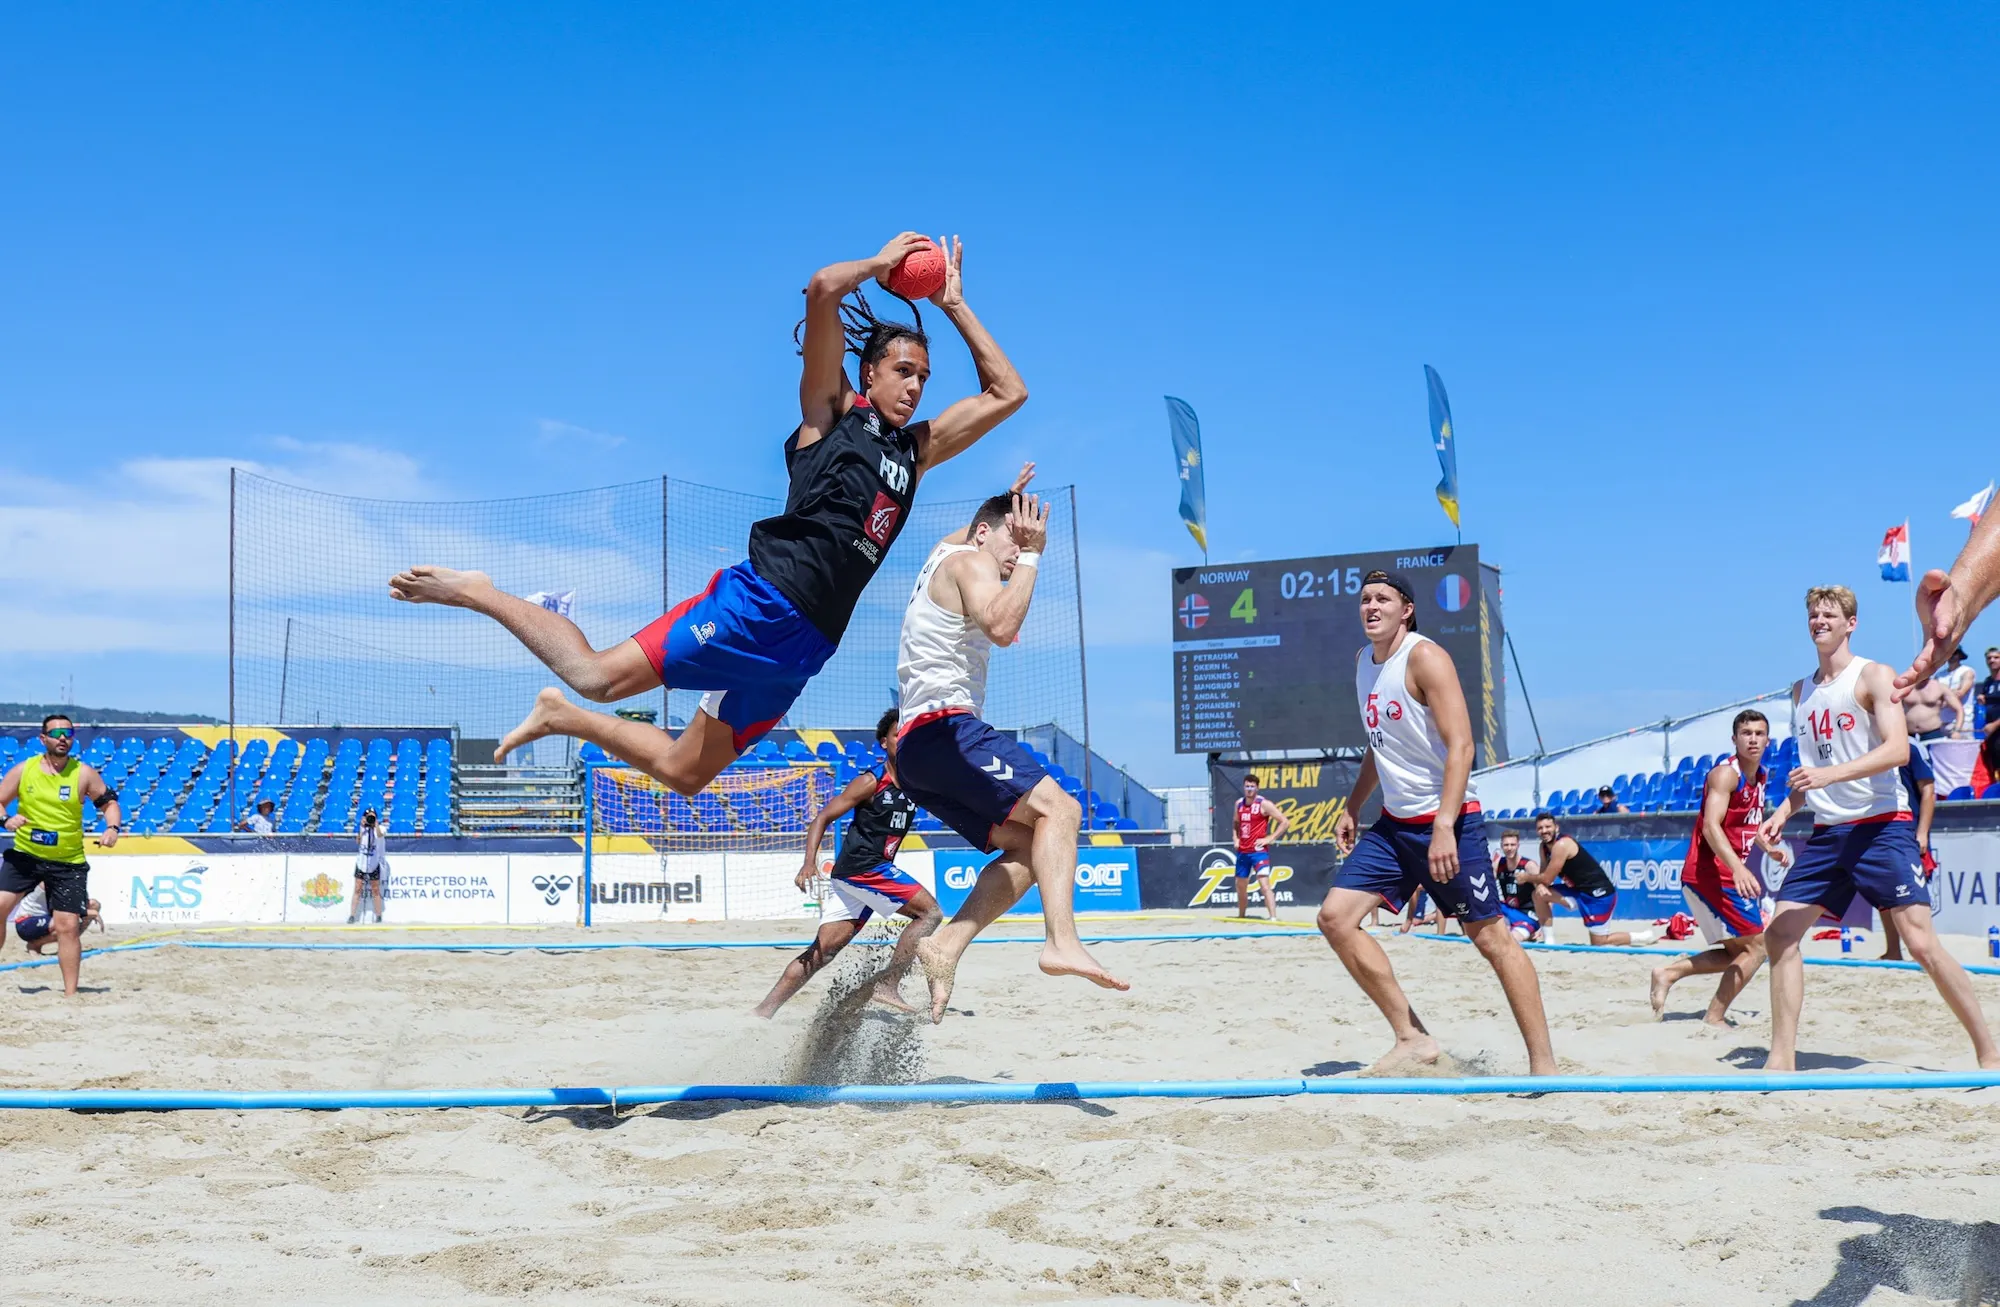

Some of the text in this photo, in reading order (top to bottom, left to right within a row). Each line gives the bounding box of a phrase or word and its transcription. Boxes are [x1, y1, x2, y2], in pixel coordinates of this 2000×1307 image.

[880, 451, 909, 495] FRA
[862, 538, 879, 555] CAISSE
[1396, 554, 1445, 570] FRANCE
[1200, 570, 1250, 585] NORWAY
[1280, 567, 1362, 600] 02:15
[1230, 588, 1257, 624] 4
[1194, 702, 1236, 710] JOHANSEN
[1366, 694, 1379, 728] 5
[1194, 722, 1226, 730] HANSEN
[1249, 720, 1255, 728] 2
[1808, 709, 1833, 742] 14
[1368, 731, 1384, 748] OR
[1281, 763, 1321, 788] PLAY
[890, 811, 907, 829] FRA
[381, 876, 488, 886] НИСТЕРСТВО НА
[130, 875, 203, 909] NBS
[431, 889, 440, 899] И
[444, 889, 496, 899] СПОРТА
[1211, 891, 1294, 903] REN-A-AR
[128, 910, 201, 923] MARITIME
